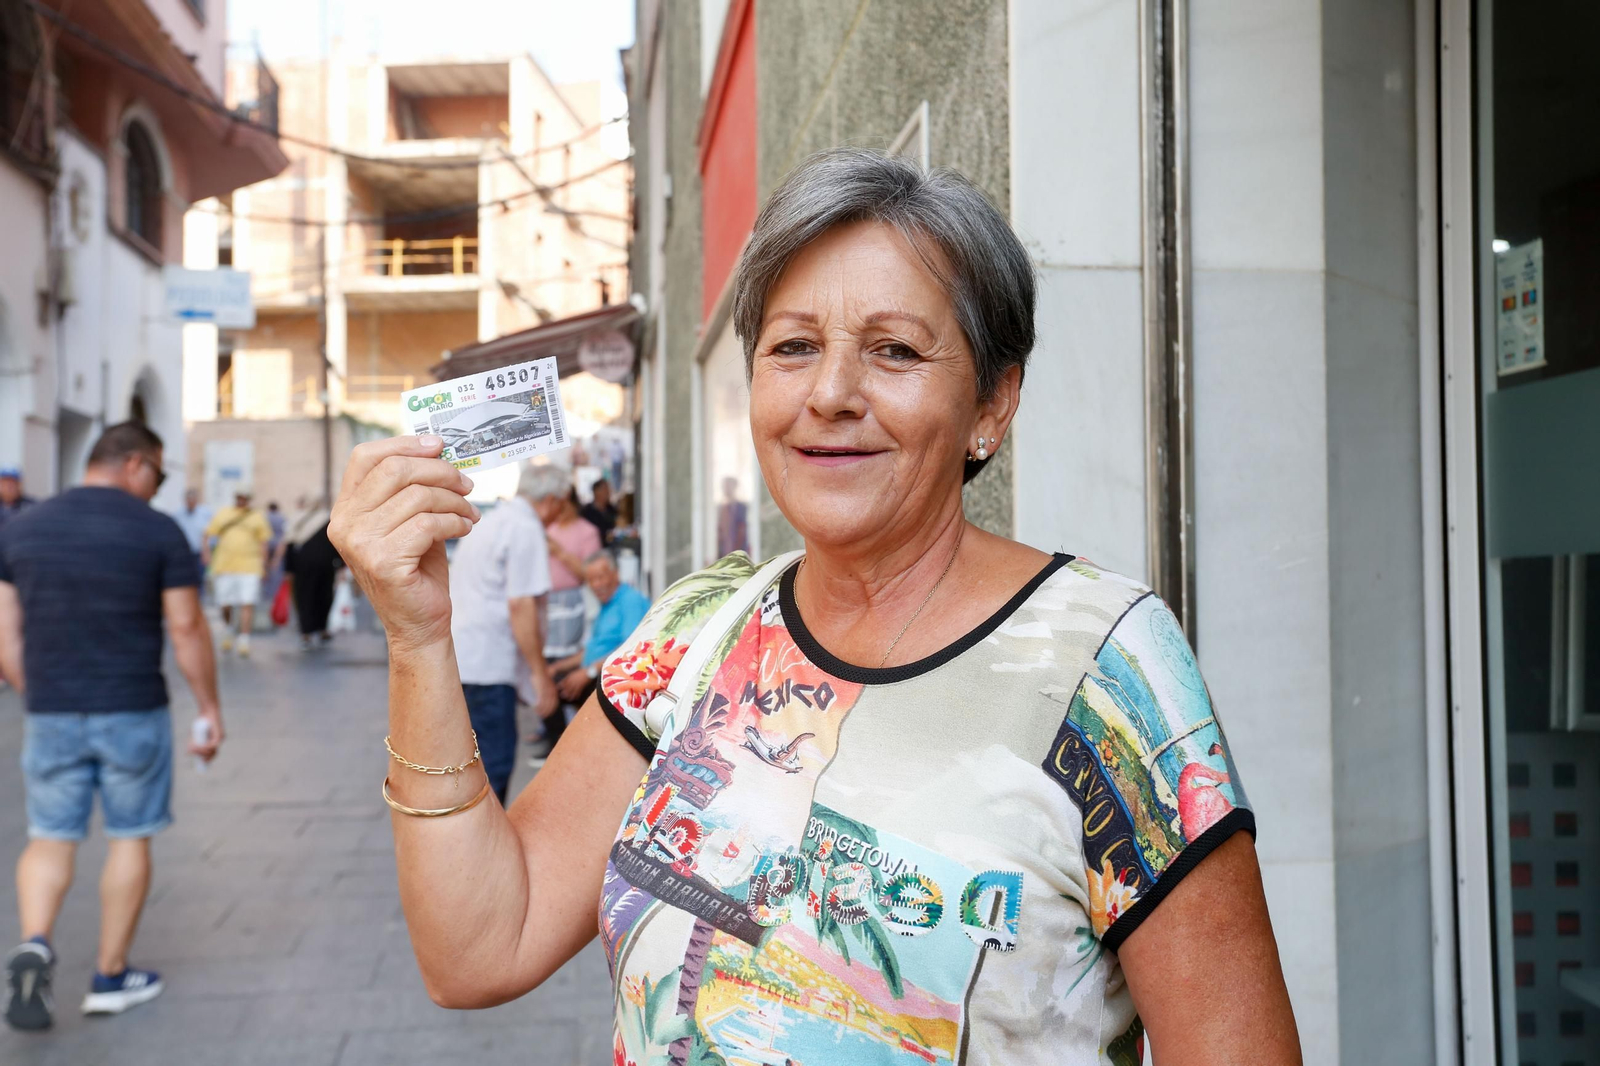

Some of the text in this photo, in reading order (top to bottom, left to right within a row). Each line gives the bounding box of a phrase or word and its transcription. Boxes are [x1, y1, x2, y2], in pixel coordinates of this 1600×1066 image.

[485, 366, 540, 391] 48307
[457, 383, 475, 393] 032
[460, 394, 477, 402] SERIE
[456, 449, 476, 458] Mercado
[516, 447, 528, 456] SEP.
[452, 459, 479, 468] ONCE
[738, 678, 837, 716] MEXICO
